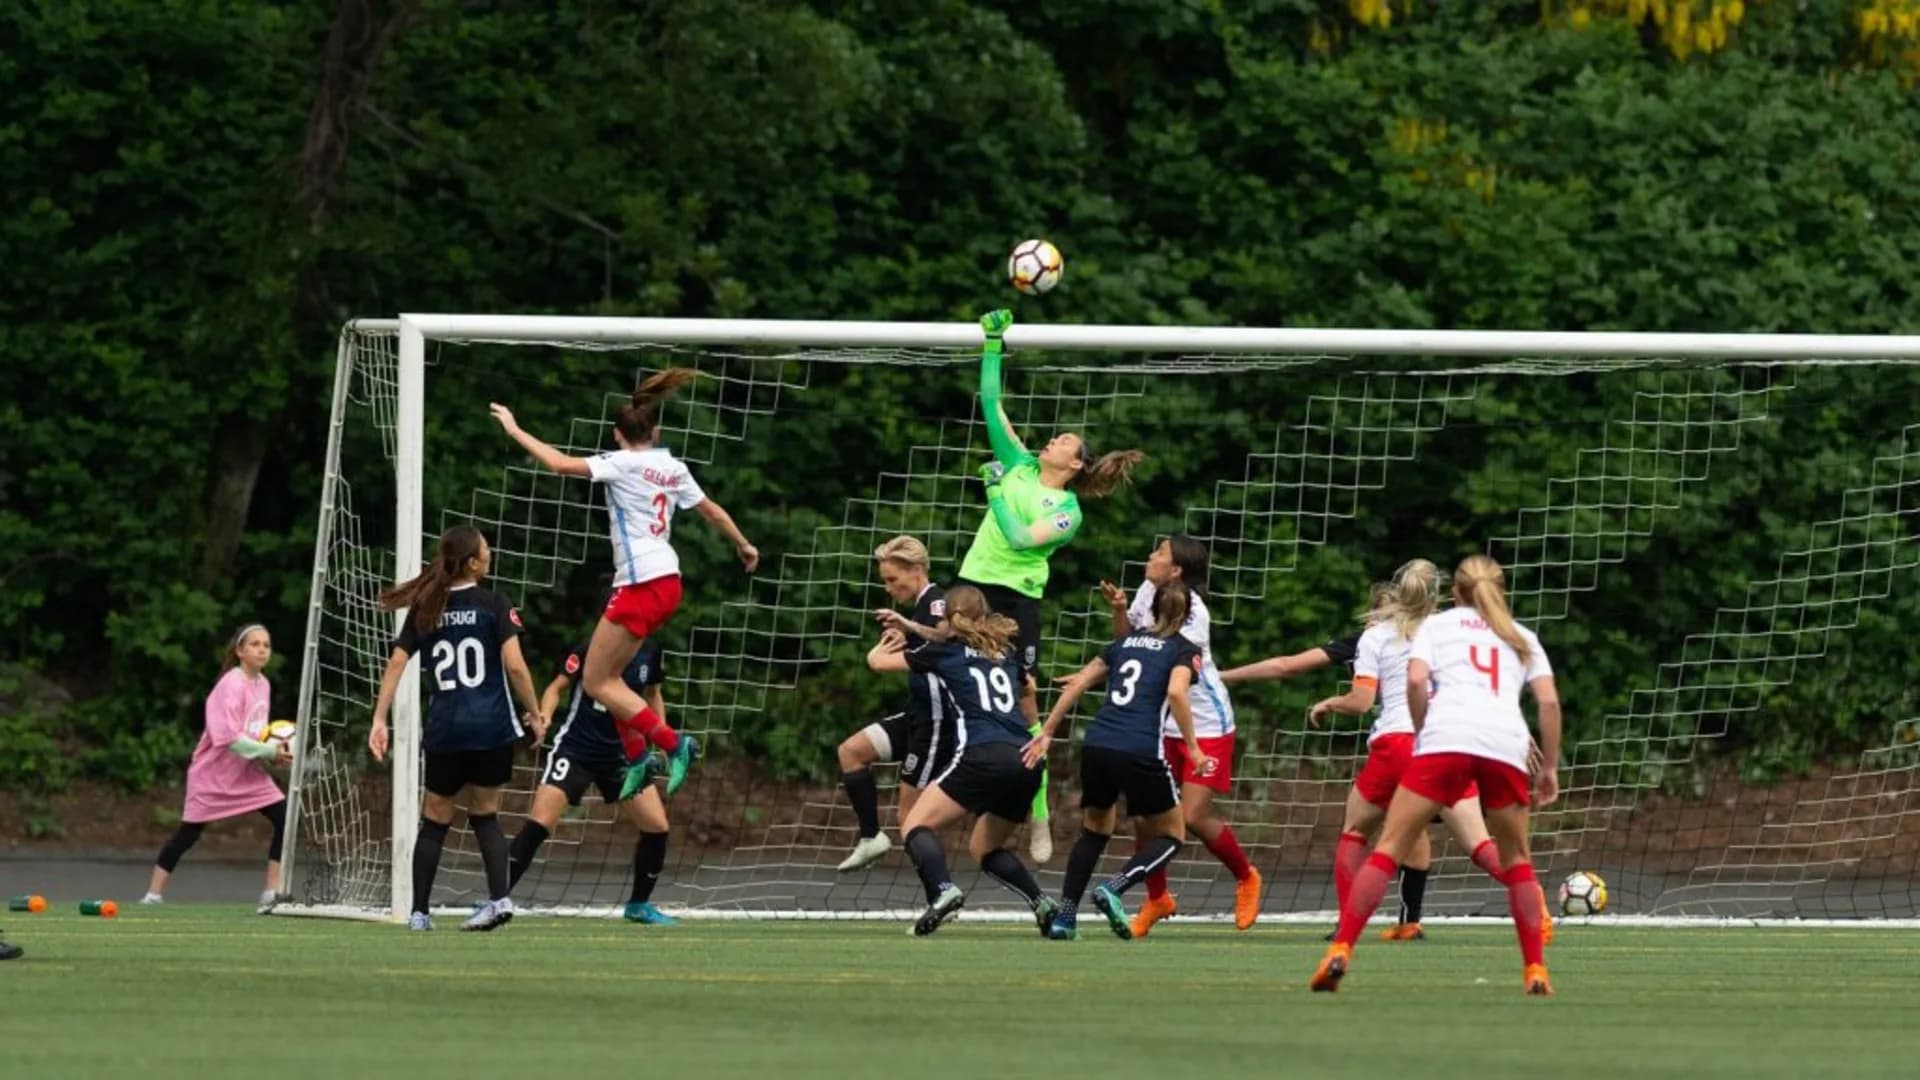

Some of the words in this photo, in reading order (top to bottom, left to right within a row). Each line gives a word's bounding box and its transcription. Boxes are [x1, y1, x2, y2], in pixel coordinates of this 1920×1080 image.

[650, 493, 667, 536] 3
[432, 637, 485, 691] 20
[1111, 659, 1142, 706] 3
[1470, 645, 1498, 694] 4
[969, 667, 1014, 713] 19
[551, 757, 570, 781] 9
